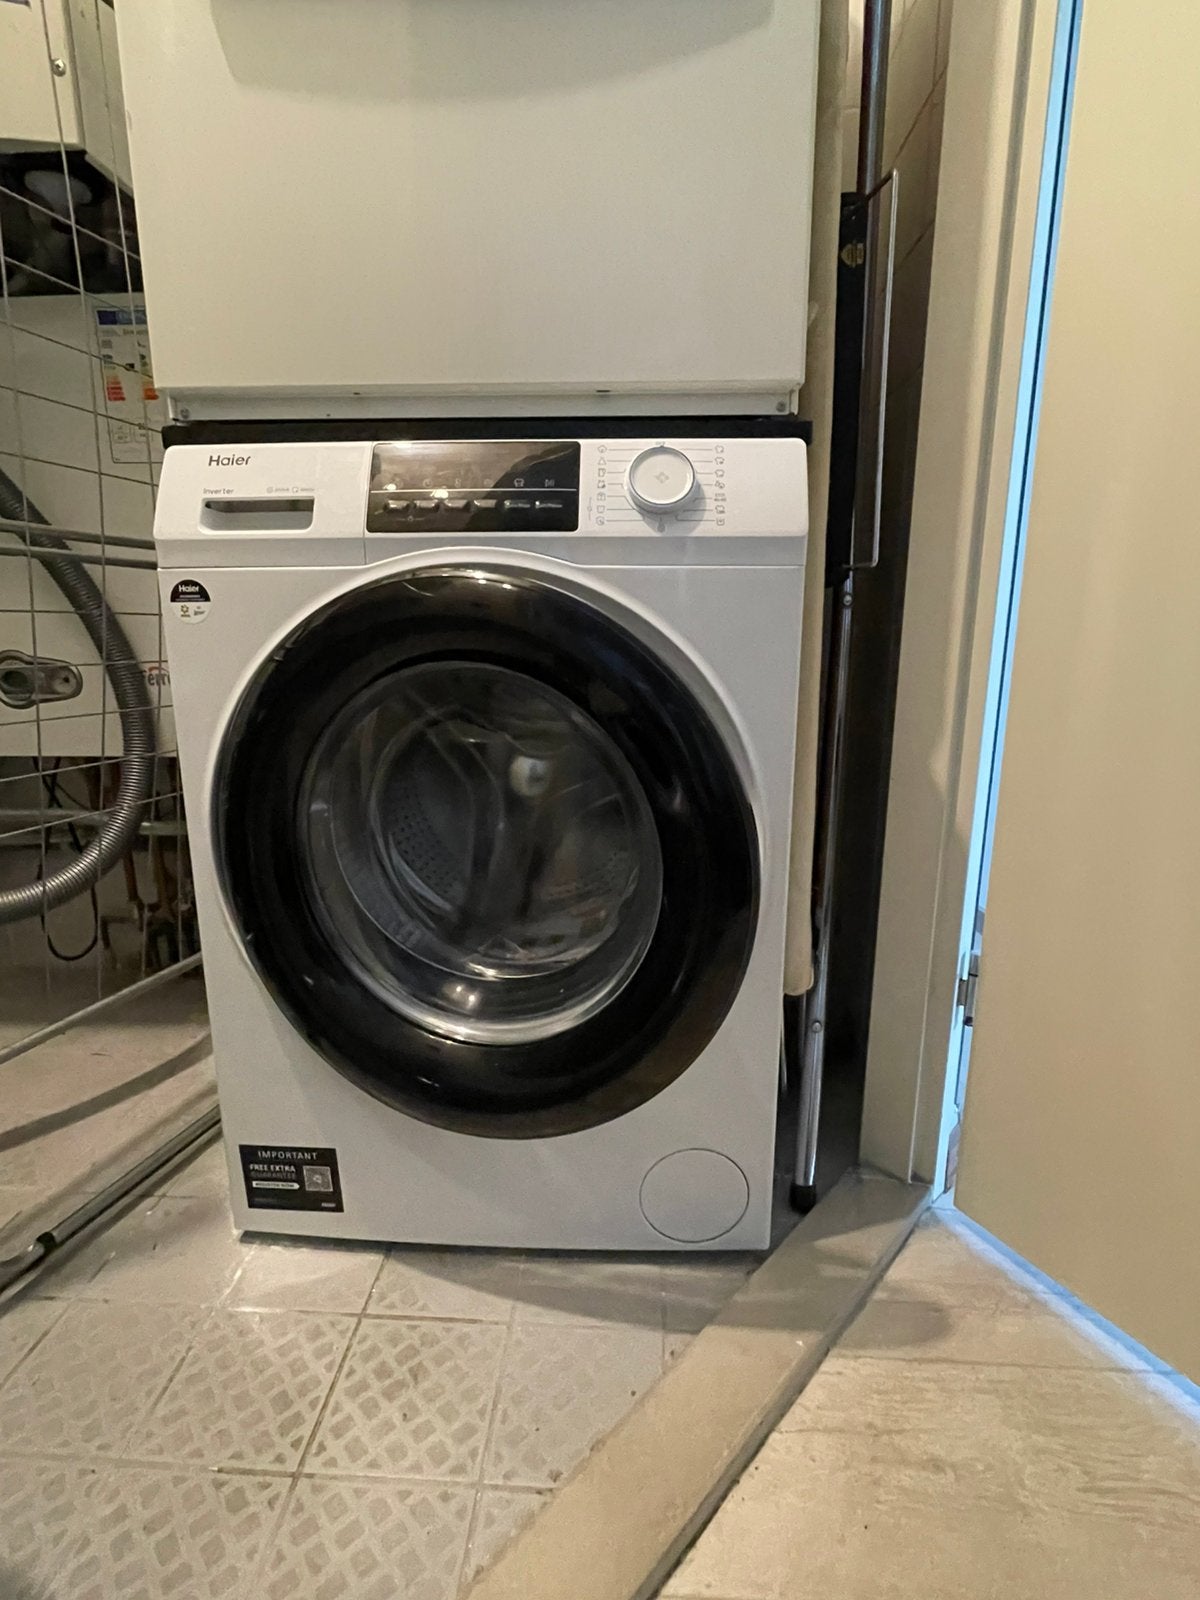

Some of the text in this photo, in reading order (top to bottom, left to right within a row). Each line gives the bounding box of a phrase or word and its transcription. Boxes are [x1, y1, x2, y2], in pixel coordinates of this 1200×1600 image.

[208, 455, 251, 467] Haier
[203, 487, 234, 495] Inverter
[178, 584, 200, 593] Haier
[257, 1150, 318, 1160] IMPORTANT
[249, 1163, 296, 1173] FREE EXTRA
